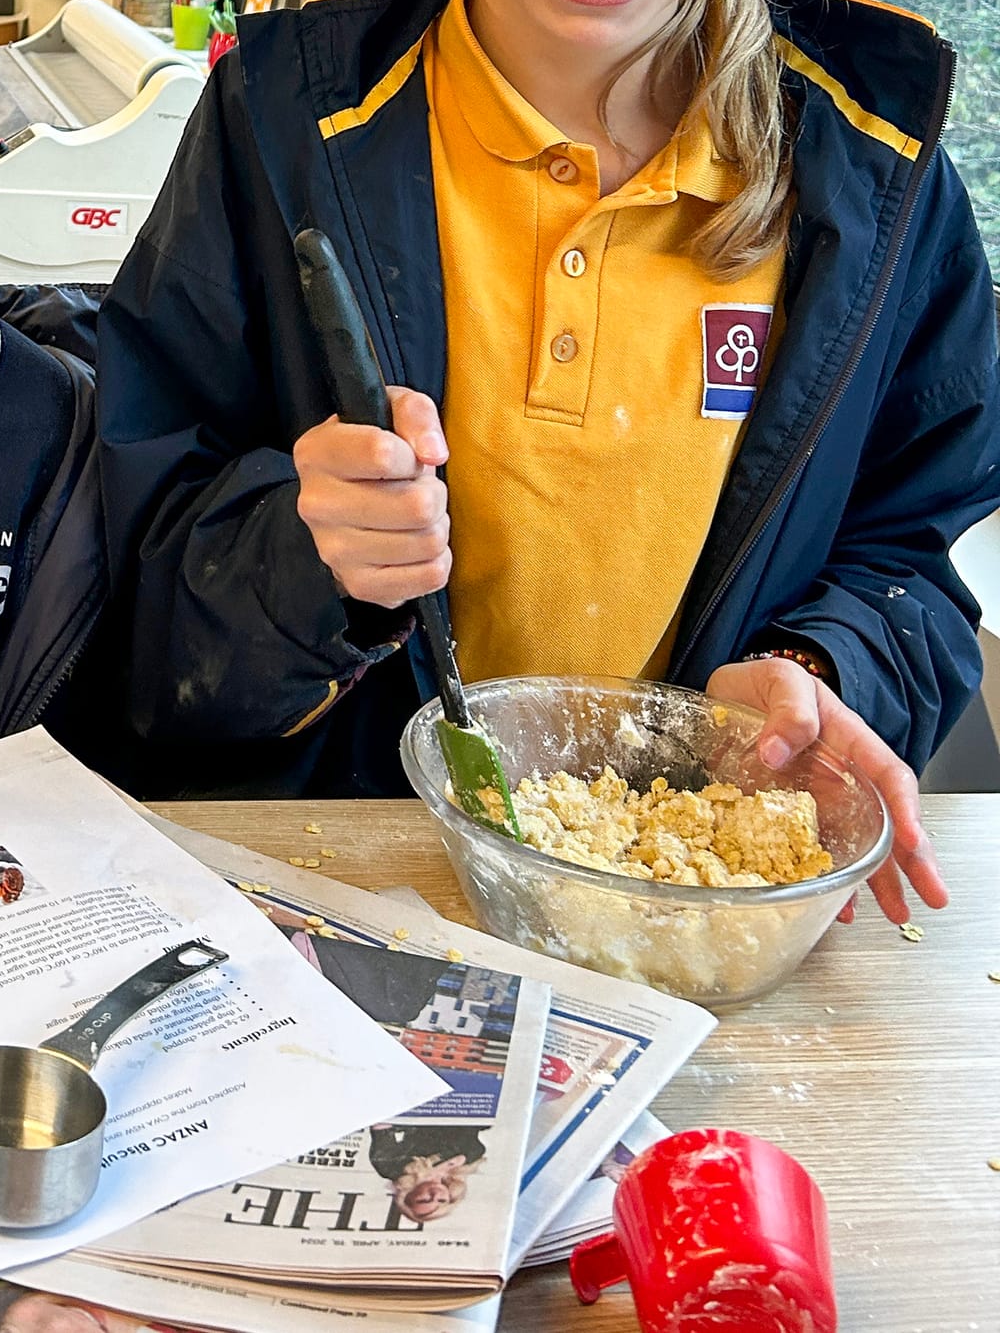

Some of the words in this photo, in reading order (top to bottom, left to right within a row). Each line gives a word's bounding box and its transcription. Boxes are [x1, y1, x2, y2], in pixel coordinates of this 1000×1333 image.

[71, 207, 122, 229] GBC
[16, 903, 47, 915] minutes
[63, 917, 81, 925] soda
[70, 921, 93, 931] syrup
[93, 917, 108, 925] and
[9, 921, 41, 934] mixture
[47, 923, 62, 932] and
[138, 925, 168, 938] Preheat
[24, 929, 45, 939] water
[72, 931, 91, 940] soda
[96, 932, 116, 941] oats,
[118, 935, 137, 944] oven
[56, 937, 71, 946] and
[64, 938, 96, 952] coconut
[25, 943, 56, 956] boiling
[48, 950, 63, 959] and
[82, 945, 108, 958] 180°C
[3, 954, 25, 965] water
[28, 955, 47, 964] then
[71, 953, 80, 961] or
[6, 962, 28, 973] sugar
[45, 957, 70, 971] 160°C
[25, 966, 43, 976] (fan
[194, 989, 210, 997] cup
[71, 993, 105, 1008] coconut
[202, 995, 220, 1004] tbsp
[146, 1002, 171, 1015] rolled
[171, 1002, 202, 1016] boiling
[211, 1003, 225, 1011] tsp
[149, 1013, 171, 1024] water
[163, 1009, 211, 1029] bicarbonate
[216, 1009, 235, 1019] tbsp
[45, 1017, 68, 1029] sugar
[187, 1015, 215, 1030] golden
[132, 1030, 152, 1040] soda
[153, 1026, 163, 1035] of
[163, 1028, 186, 1040] syrup
[197, 1023, 226, 1036] butter,
[222, 1017, 296, 1049] Ingredients
[161, 1035, 196, 1052] chopped
[163, 1086, 192, 1100] Makes
[207, 1082, 245, 1102] Adapted
[186, 1098, 207, 1109] from
[170, 1106, 186, 1116] the
[152, 1119, 207, 1146] ANZAC
[223, 1182, 424, 1232] THE
[300, 1237, 326, 1245] 2024
[280, 1298, 328, 1312] Continued
